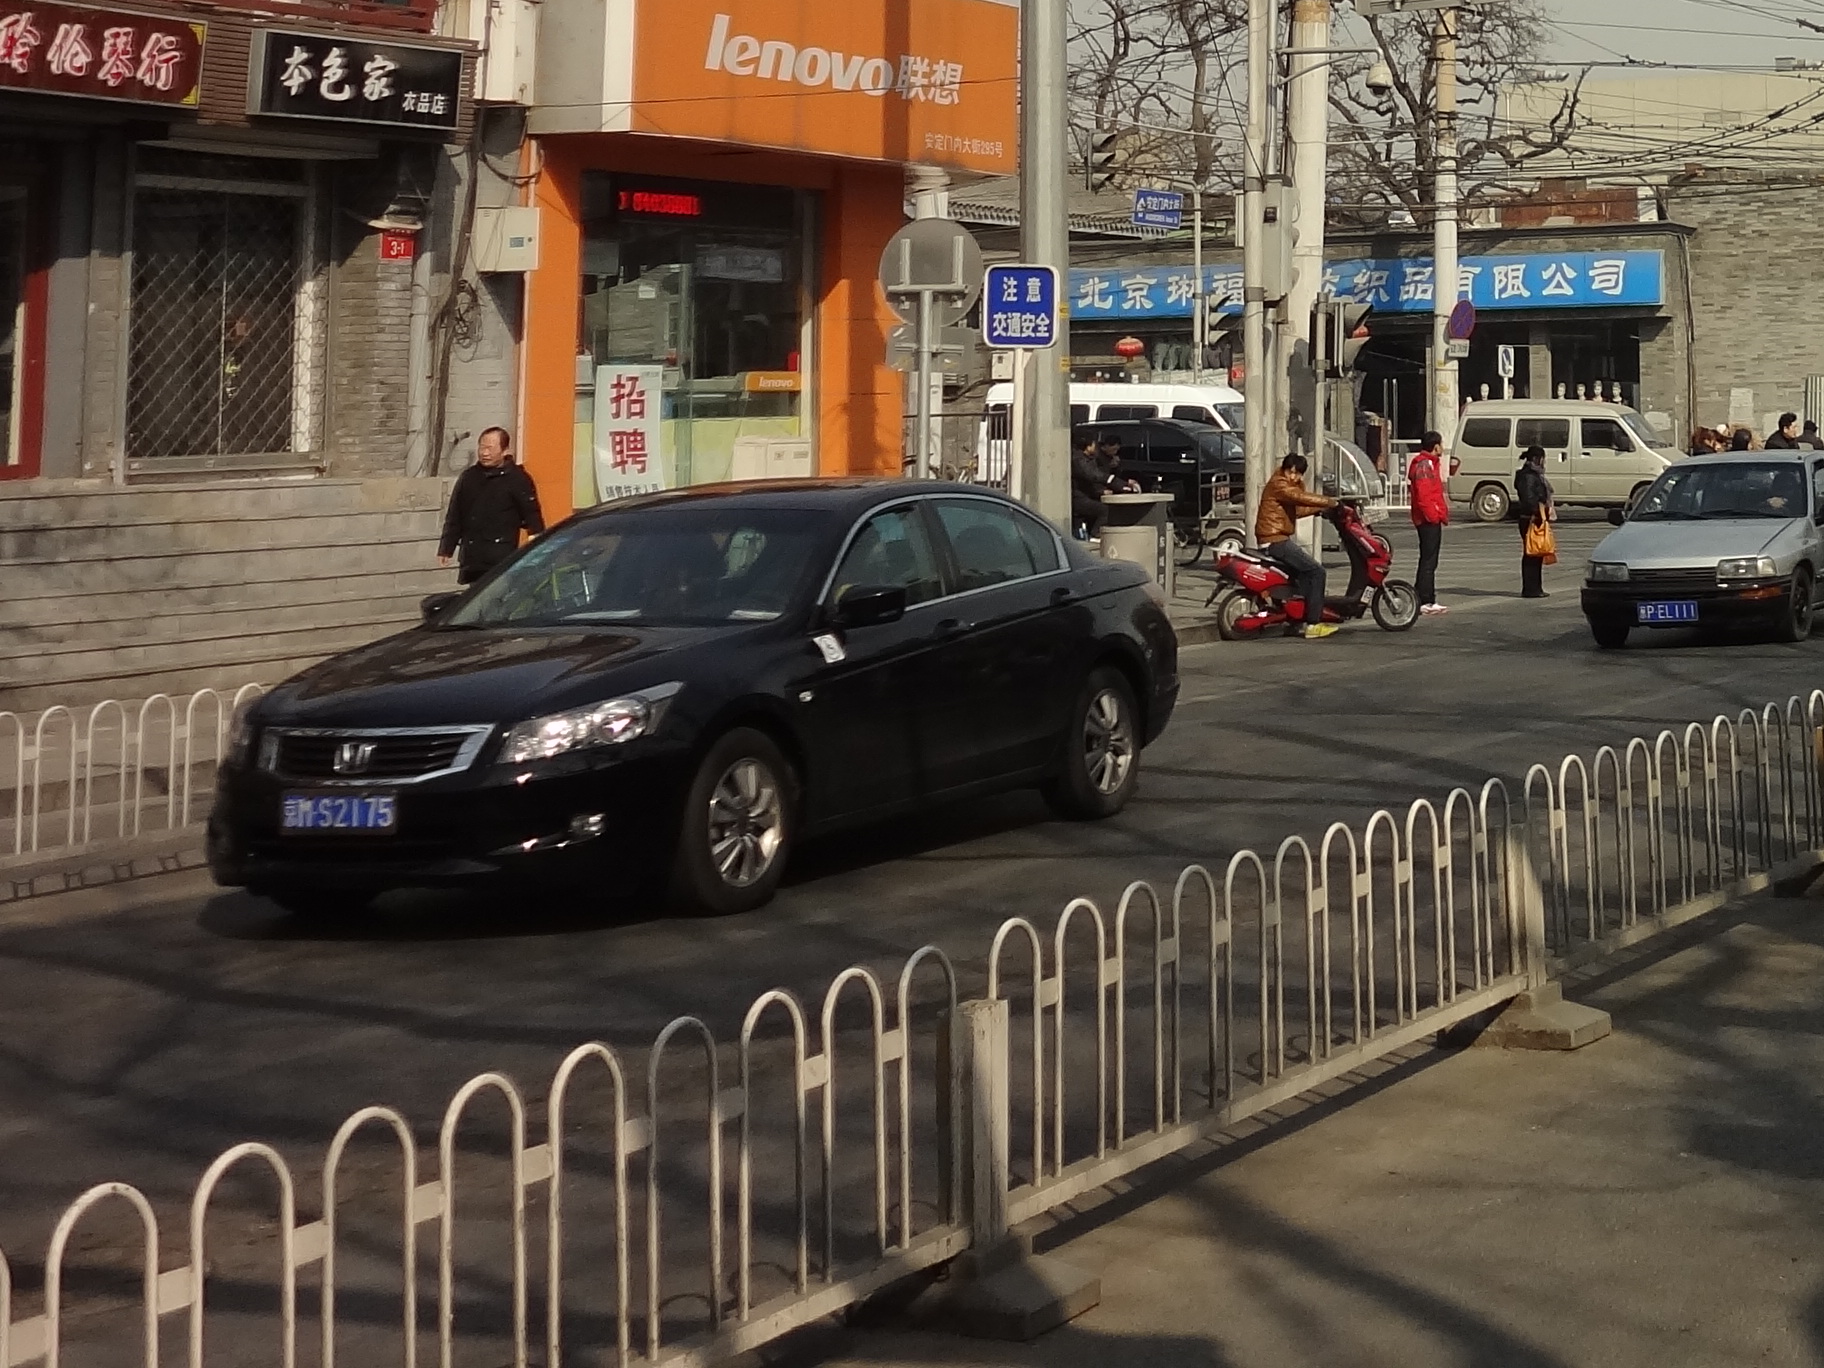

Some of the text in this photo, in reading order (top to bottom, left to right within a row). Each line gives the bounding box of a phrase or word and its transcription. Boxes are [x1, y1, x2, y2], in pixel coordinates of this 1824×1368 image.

[704, 13, 894, 96] lenovo
[895, 53, 964, 106] 联想
[402, 91, 448, 115] 衣品店
[1002, 277, 1041, 303] 注意
[993, 312, 1050, 338] 交通安全
[759, 376, 793, 388] lenovo
[609, 374, 648, 475] 招聘
